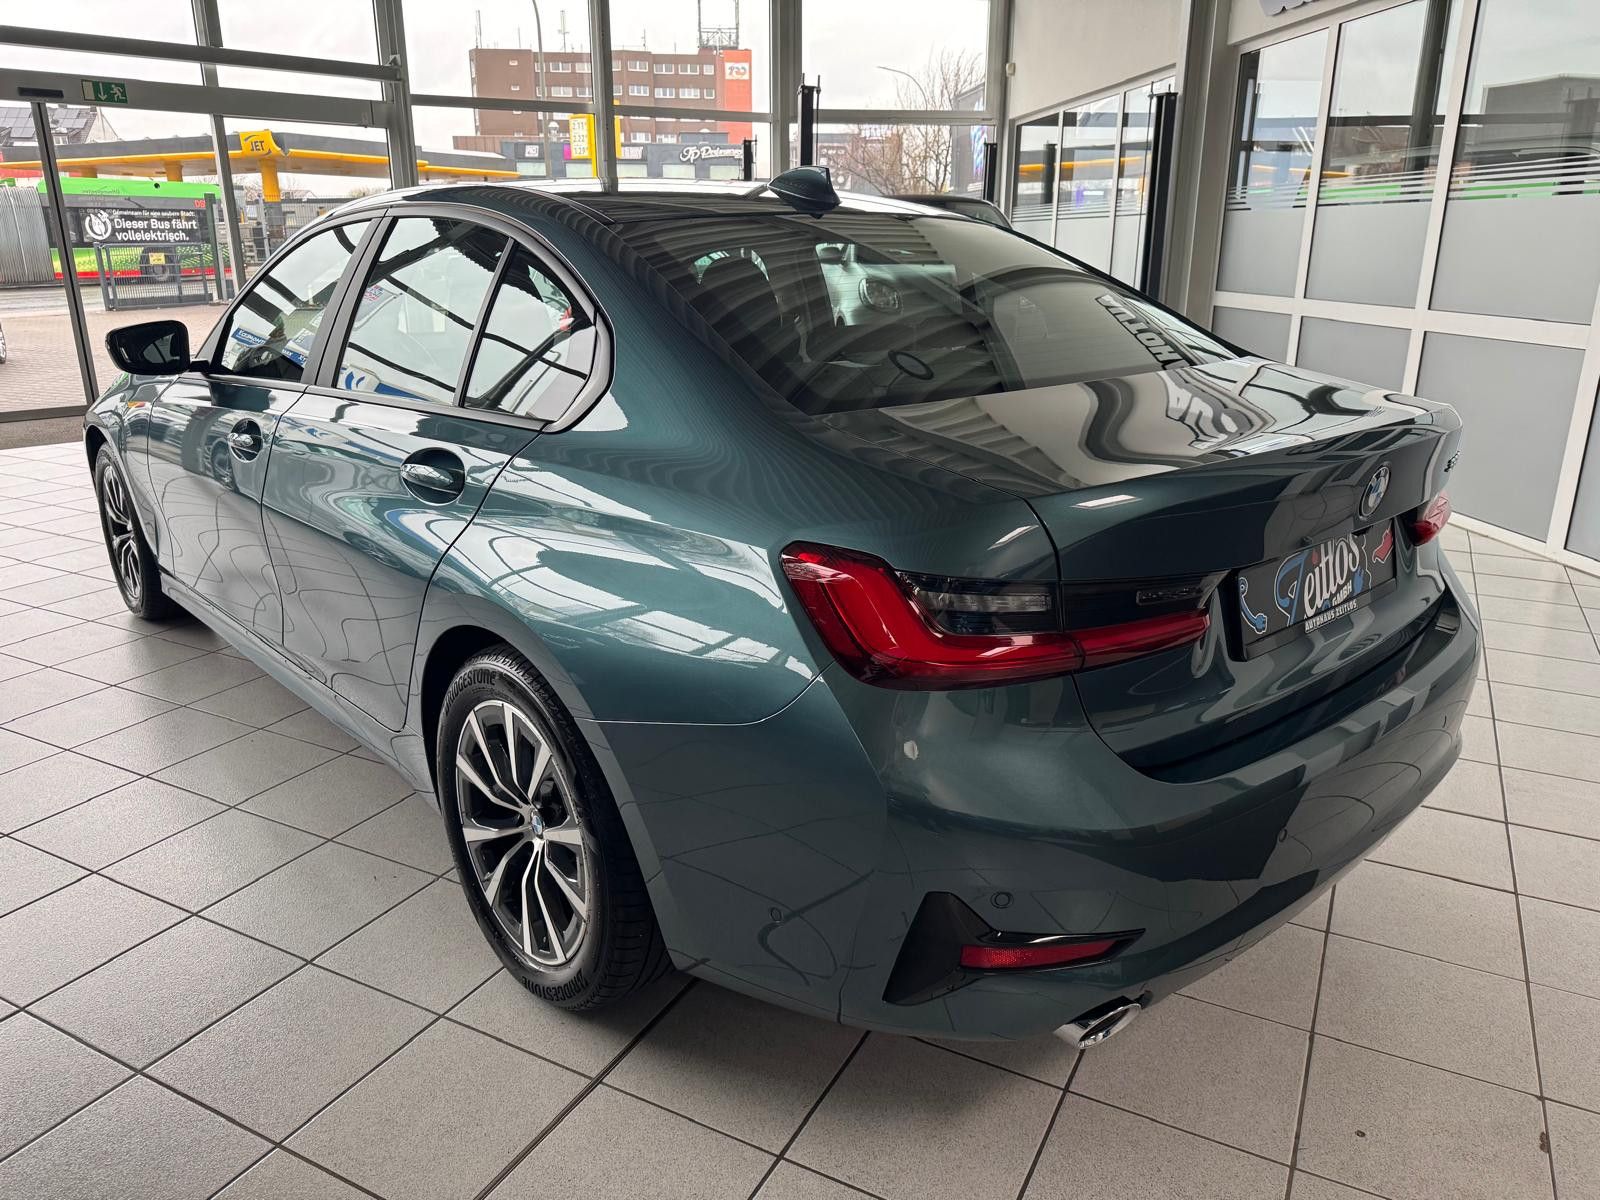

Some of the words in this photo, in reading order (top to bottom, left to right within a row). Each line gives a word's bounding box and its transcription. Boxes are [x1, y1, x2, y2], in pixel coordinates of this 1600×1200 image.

[250, 140, 265, 151] JET
[114, 218, 149, 229] Dieser
[150, 219, 170, 229] Bus
[171, 219, 198, 229] fährt
[116, 230, 190, 241] vollelektrisch.
[1304, 611, 1335, 632] AUTOHAUS
